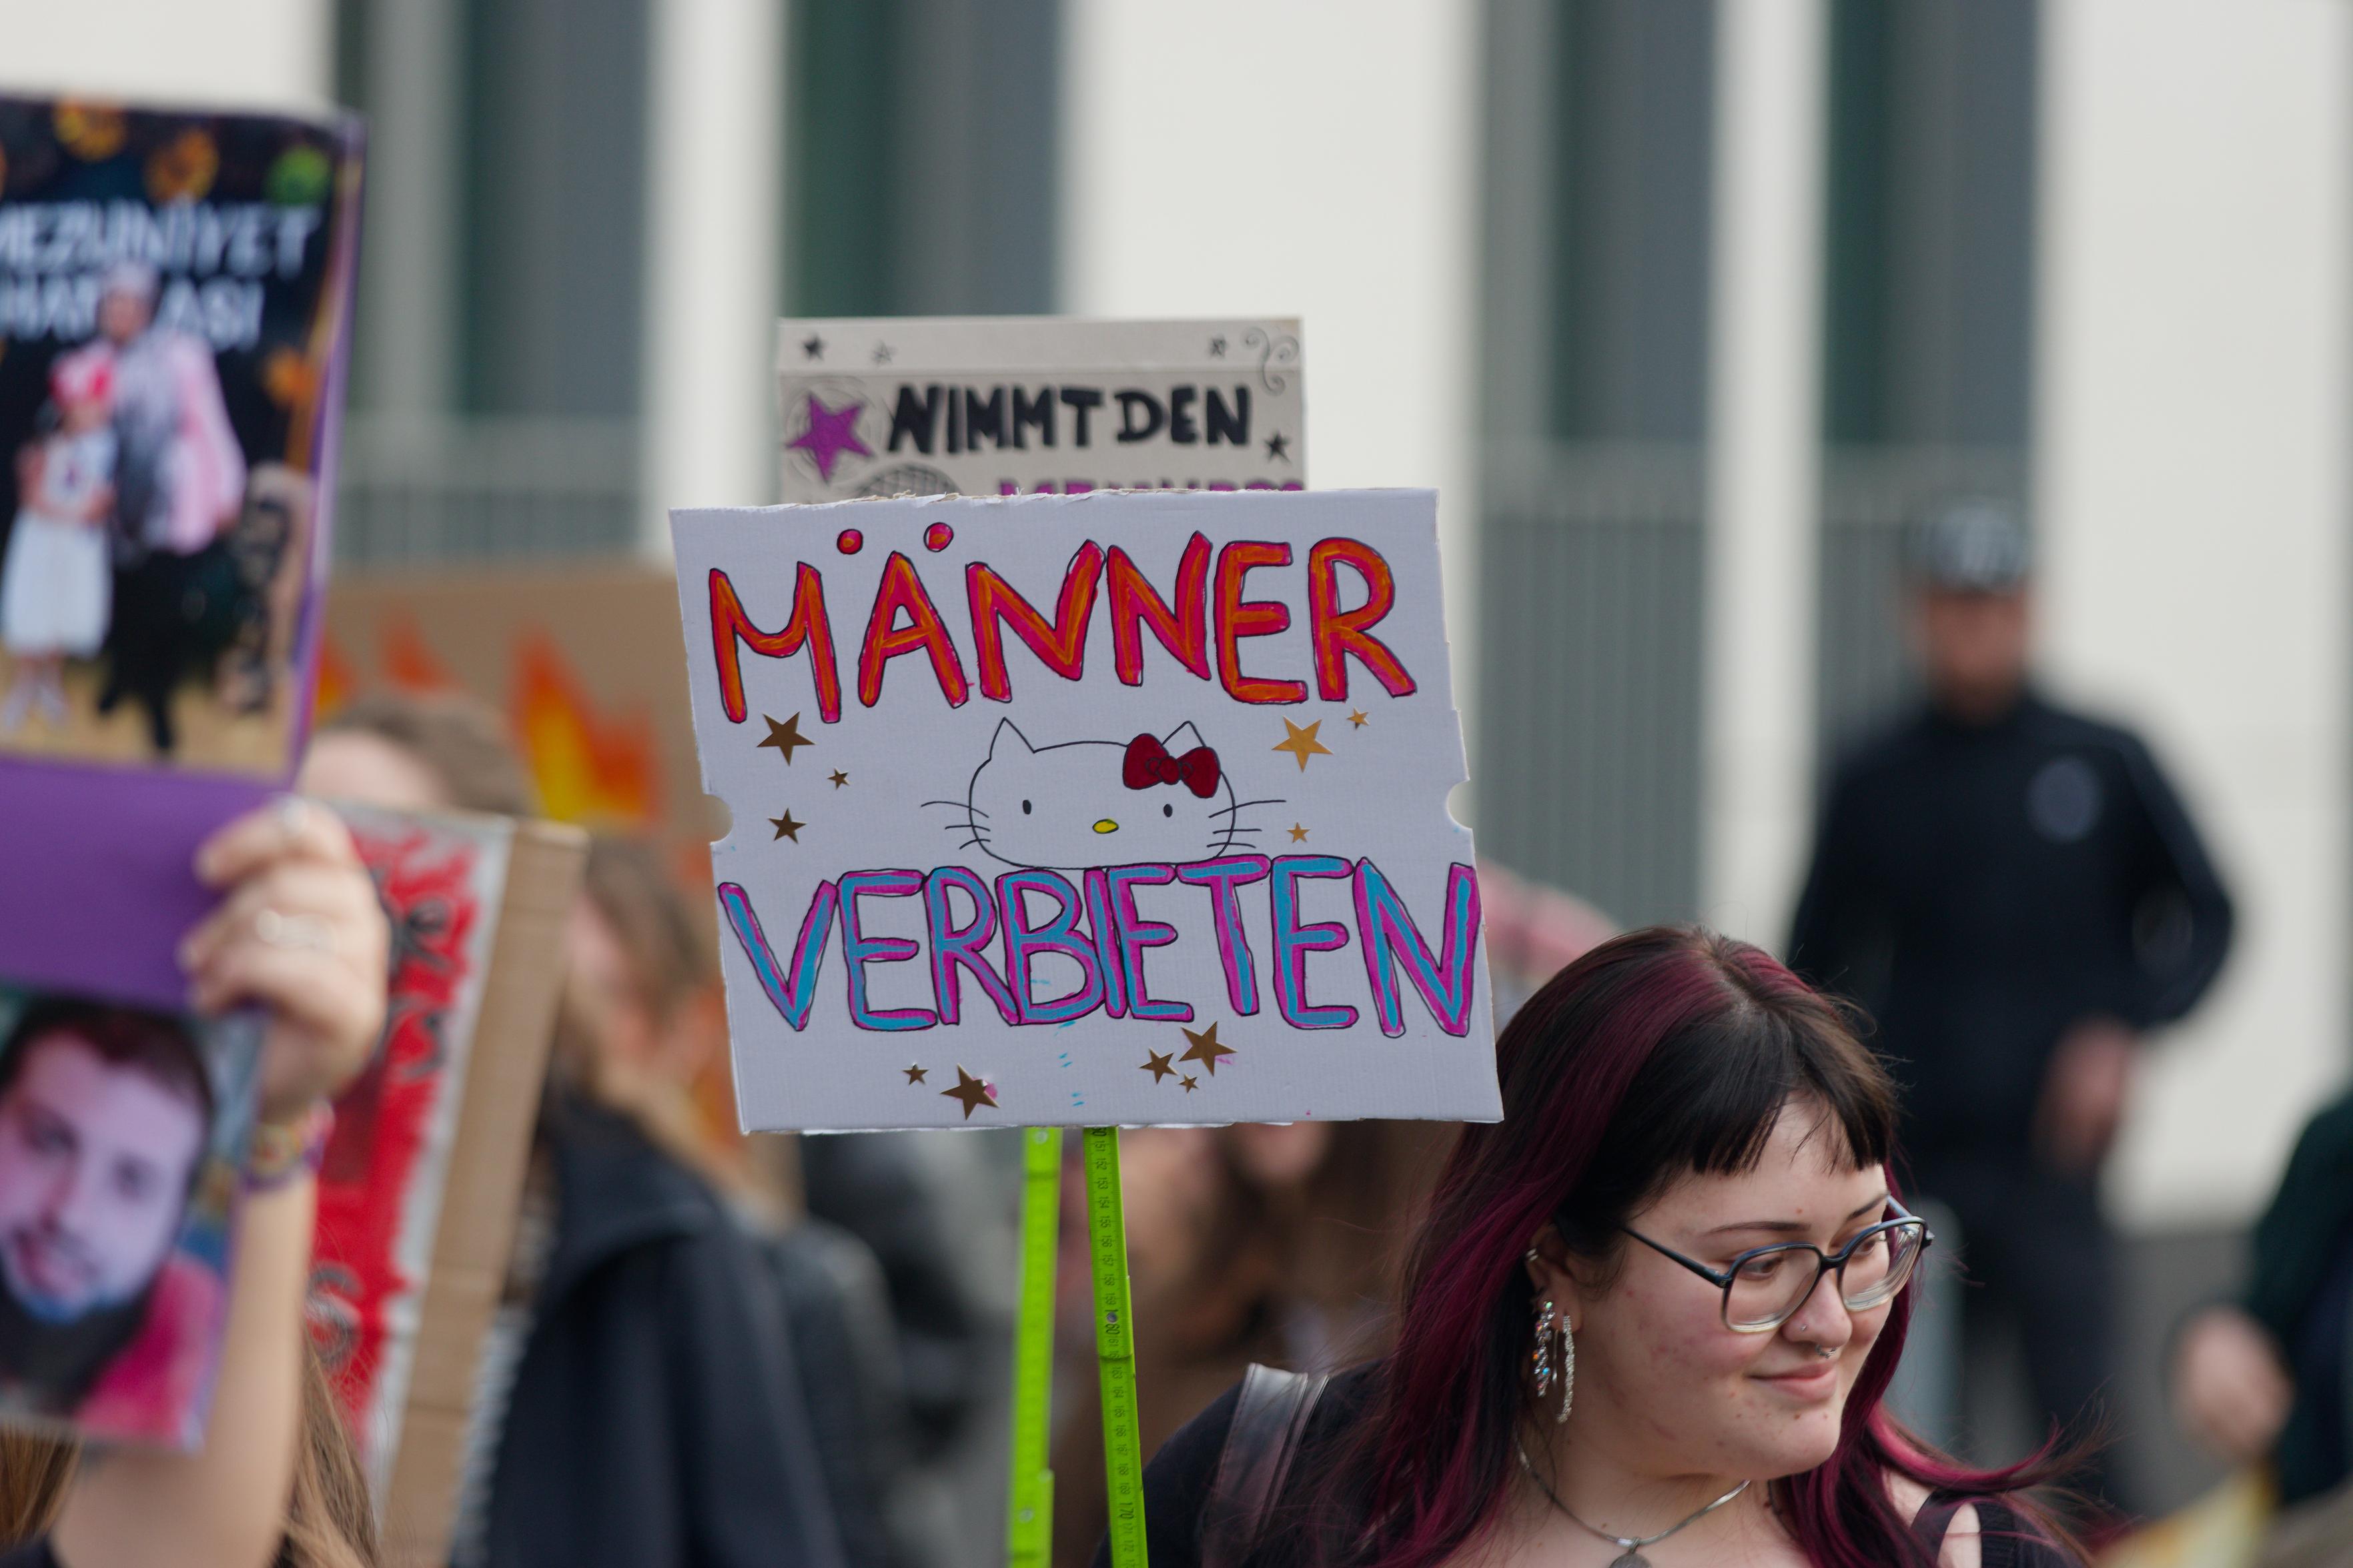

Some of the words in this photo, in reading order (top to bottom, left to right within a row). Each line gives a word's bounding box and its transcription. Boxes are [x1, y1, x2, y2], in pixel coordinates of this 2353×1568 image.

[887, 383, 1105, 454] NIMMT
[1115, 385, 1251, 447] DEN
[708, 520, 1418, 726] MÄNNER
[717, 854, 1481, 1038] VERBIETEN
[1095, 1140, 1105, 1152] 151
[1097, 1158, 1107, 1170] 152
[1097, 1177, 1108, 1190] 153
[1099, 1197, 1109, 1209] 154
[1102, 1255, 1113, 1266] 157
[1119, 1502, 1134, 1519] 170
